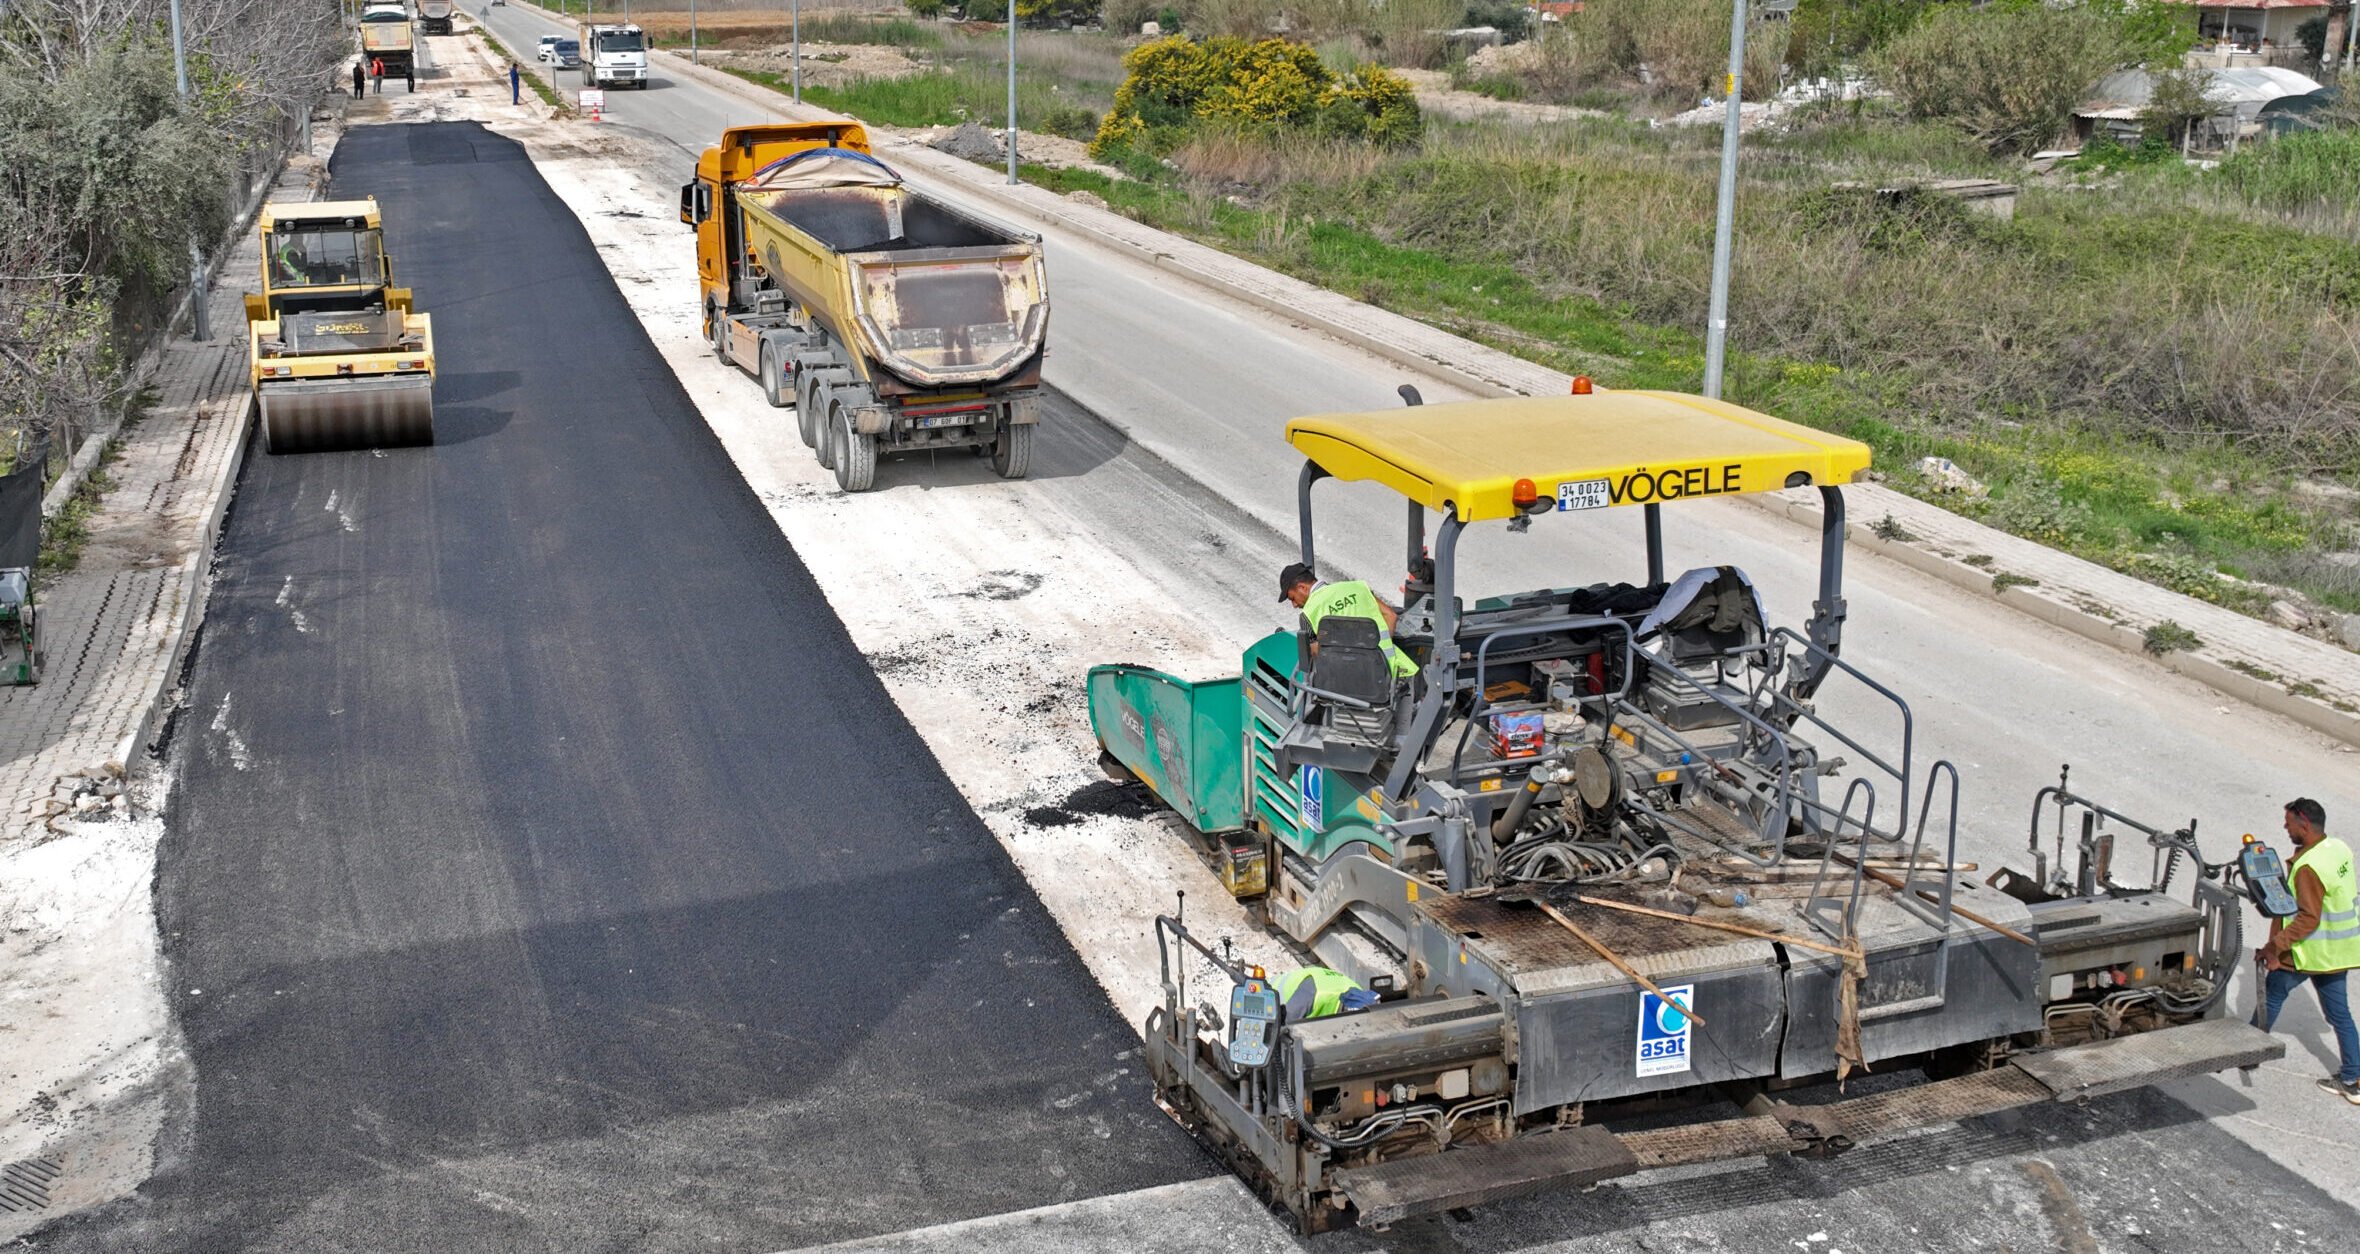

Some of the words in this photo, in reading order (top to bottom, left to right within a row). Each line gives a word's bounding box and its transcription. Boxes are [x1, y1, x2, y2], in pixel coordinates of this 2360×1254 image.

[1562, 485, 1575, 497] 34
[1578, 482, 1606, 495] 0023
[1604, 464, 1742, 504] VÖGELE
[1570, 495, 1600, 508] 17784
[1329, 594, 1357, 614] ASAT
[1301, 899, 1322, 933] SUPER
[1641, 1037, 1686, 1057] asat
